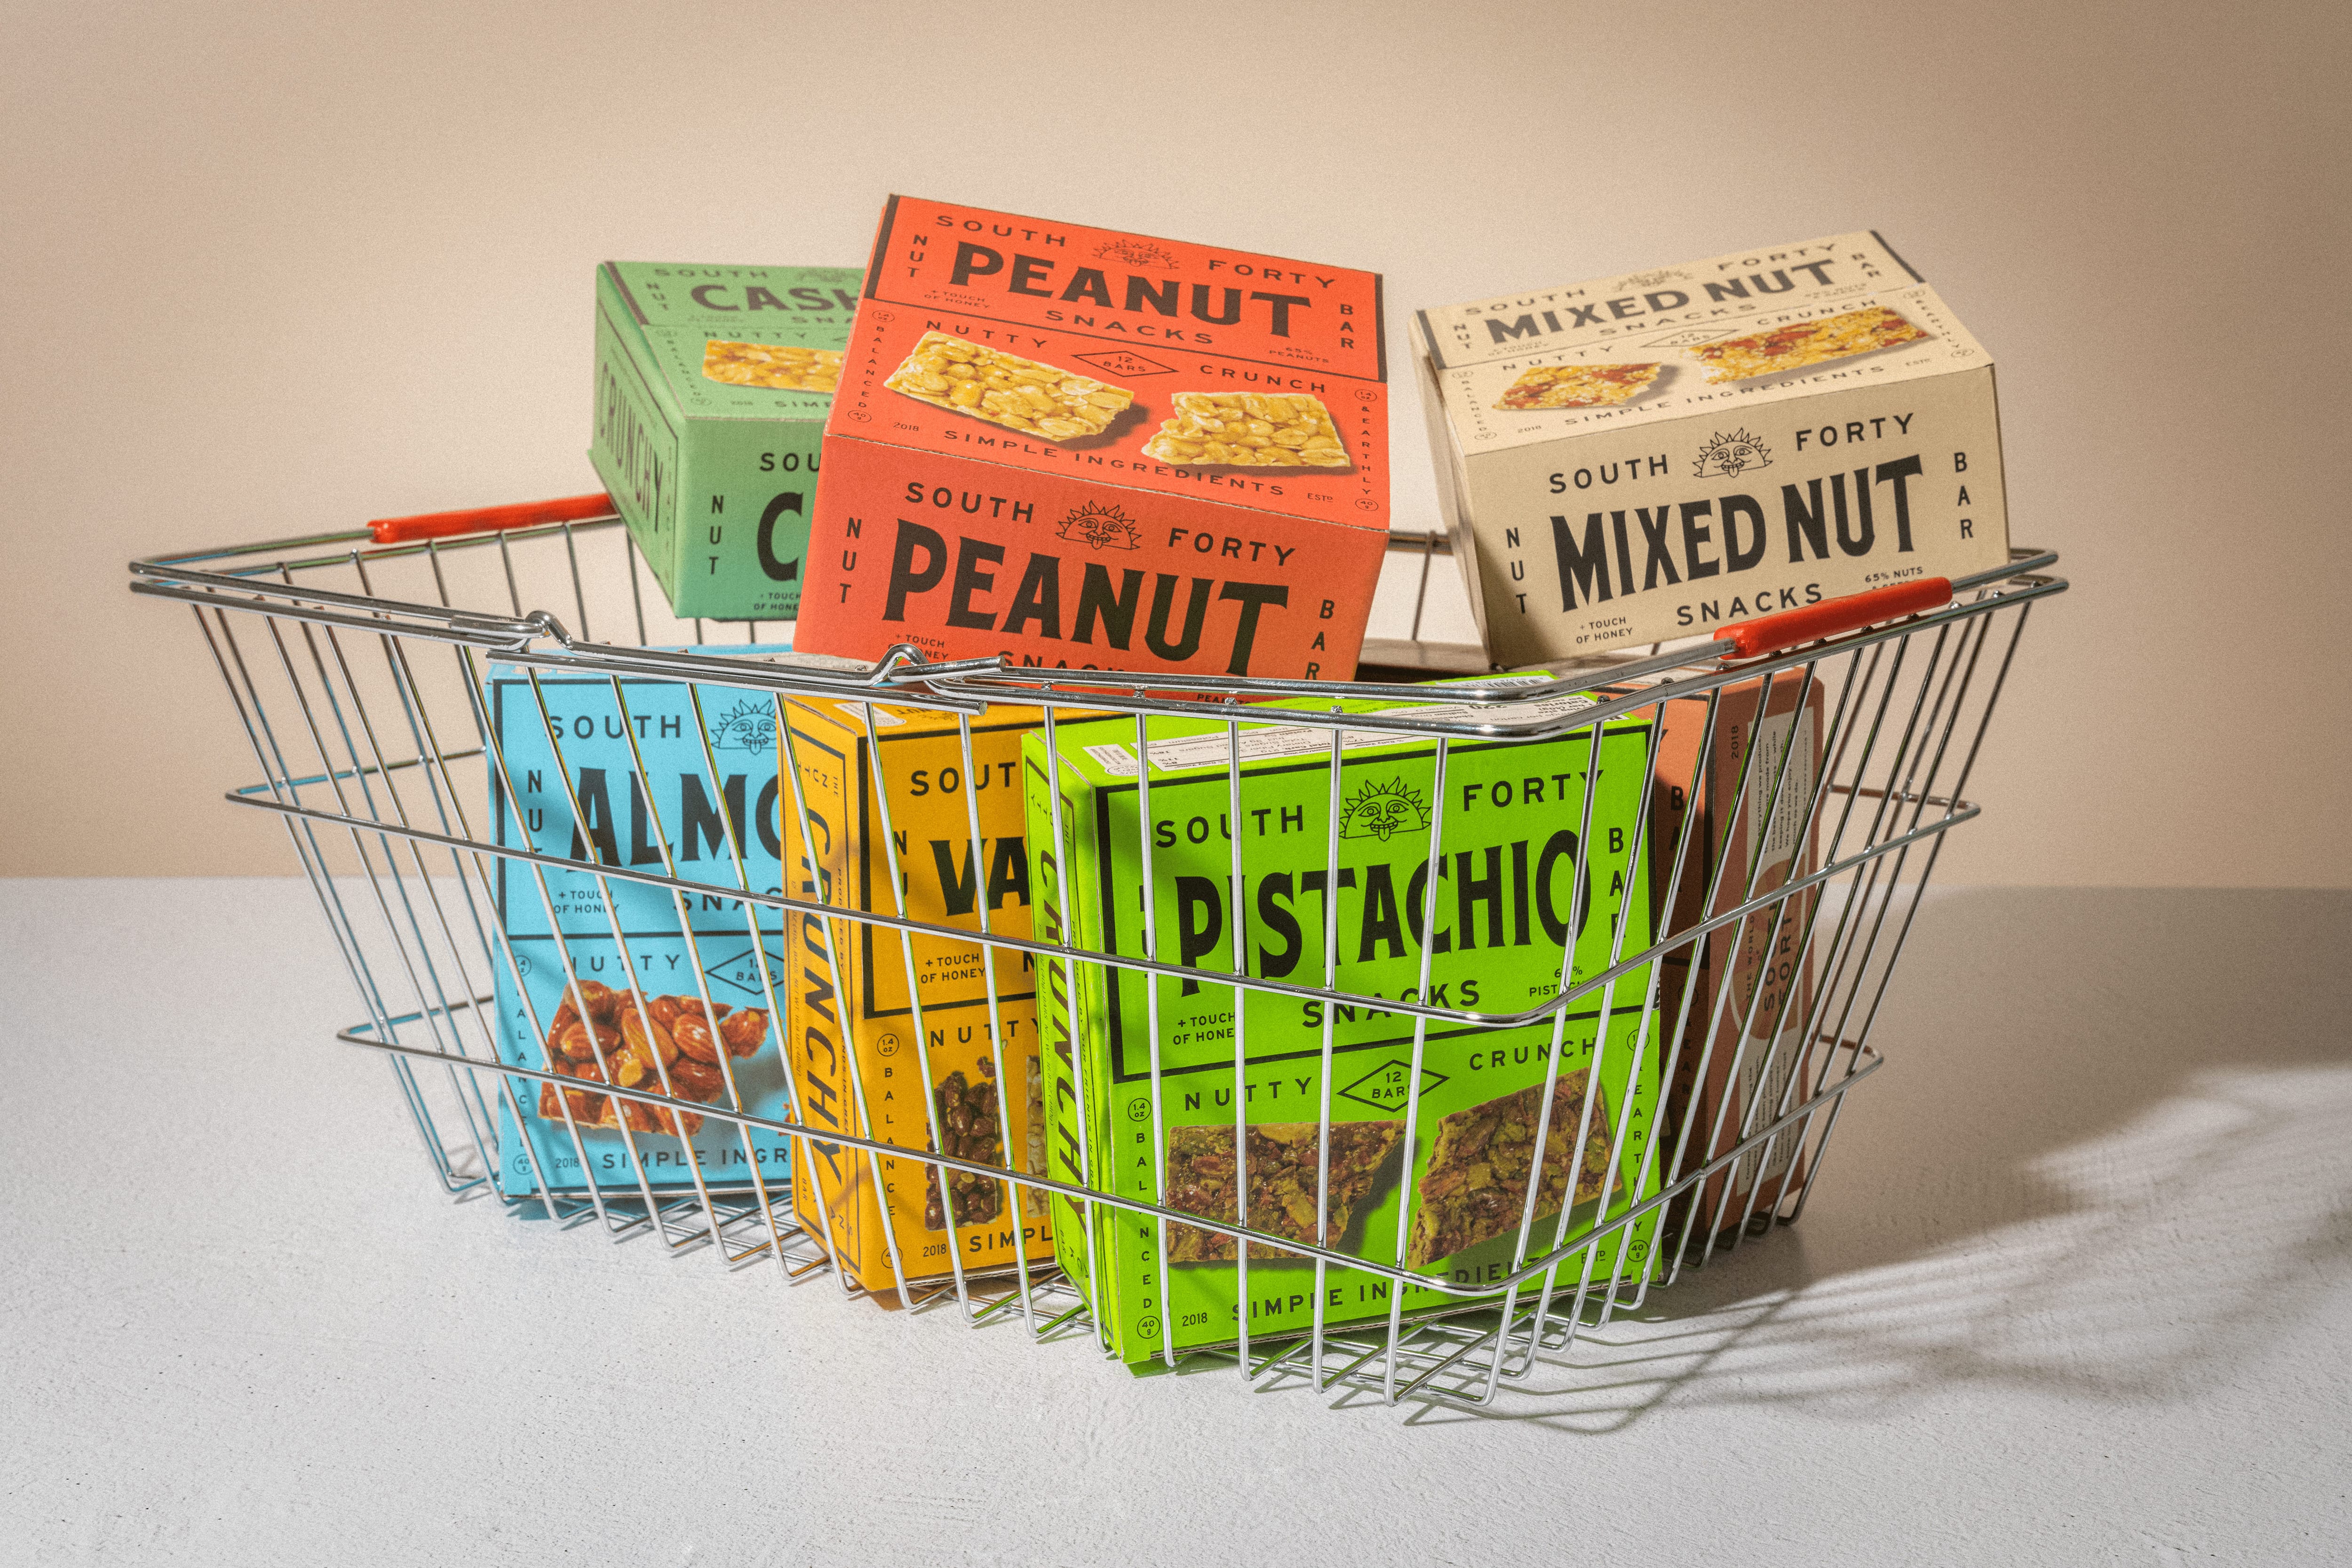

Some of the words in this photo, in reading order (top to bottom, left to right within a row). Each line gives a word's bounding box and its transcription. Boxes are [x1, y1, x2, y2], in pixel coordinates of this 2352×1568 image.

[908, 234, 927, 277] NUT
[936, 215, 1065, 247] SOUTH
[1209, 260, 1335, 288] FORTY
[655, 269, 768, 278] SOUTH
[949, 240, 1311, 338] PEANUT
[1465, 289, 1585, 315] SOUTH
[1717, 243, 1835, 271] FORTY
[943, 291, 985, 302] TOUCH
[946, 298, 990, 308] HONEY
[1485, 290, 1690, 344] MIXED
[1702, 259, 1835, 302] NUT
[1046, 310, 1213, 344] SNACKS
[1340, 304, 1354, 349] BAR
[1454, 324, 1470, 349] NUT
[1502, 345, 1613, 371] NUTTY
[1757, 299, 1877, 325] CRUNCH
[1600, 303, 1756, 336] SNACKS
[858, 326, 884, 407] BALANCED
[926, 320, 1047, 348] NUTTY
[1200, 365, 1325, 393] CRUNCH
[1104, 361, 1145, 372] BARS
[1270, 350, 1329, 363] PEANUTS
[1565, 402, 1671, 425] SIMPLE
[1686, 366, 1884, 404] INGREDIENTS
[893, 422, 919, 432] 2018
[944, 430, 1057, 458] SIMPLE
[1075, 453, 1284, 495] INGREDIENTS
[1361, 418, 1371, 494] EARTHLY
[1549, 454, 1669, 493] SOUTH
[1796, 413, 1914, 451] FORTY
[1955, 452, 1973, 539] BAR
[708, 495, 724, 575] NUT
[905, 482, 1034, 524] SOUTH
[1168, 527, 1295, 566] FORTY
[1549, 494, 1766, 613] MIXED
[1781, 454, 1923, 564] NUT
[840, 517, 862, 604] NUT
[1506, 527, 1526, 614] NUT
[1865, 572, 1889, 582] 65%
[1894, 566, 1923, 578] NUTS
[882, 518, 1289, 677] PEANUT
[1677, 583, 1822, 626] SNACKS
[906, 634, 945, 648] TOUCH
[1305, 599, 1335, 680] BAR
[1576, 635, 1590, 644] OF
[1595, 628, 1633, 641] HONEY
[1589, 617, 1626, 629] TOUCH
[840, 952, 844, 970] BY
[921, 973, 937, 984] OF
[942, 968, 985, 981] HONEY
[937, 954, 979, 966] TOUCH
[1173, 1033, 1191, 1045] OF
[1190, 1011, 1236, 1027] TOUCH
[1079, 1007, 1084, 1027] BY
[1089, 1138, 1093, 1153] IN
[1185, 1077, 1312, 1111] NUTTY
[1469, 1037, 1595, 1071] CRUNCH
[1372, 1084, 1410, 1099] BAR
[1386, 1071, 1401, 1082] 12
[556, 1159, 579, 1168] 2018
[1136, 1132, 1152, 1309] BALNCED
[923, 1244, 946, 1257] 2018
[1142, 1320, 1155, 1329] 40
[1182, 1313, 1208, 1327] 2018
